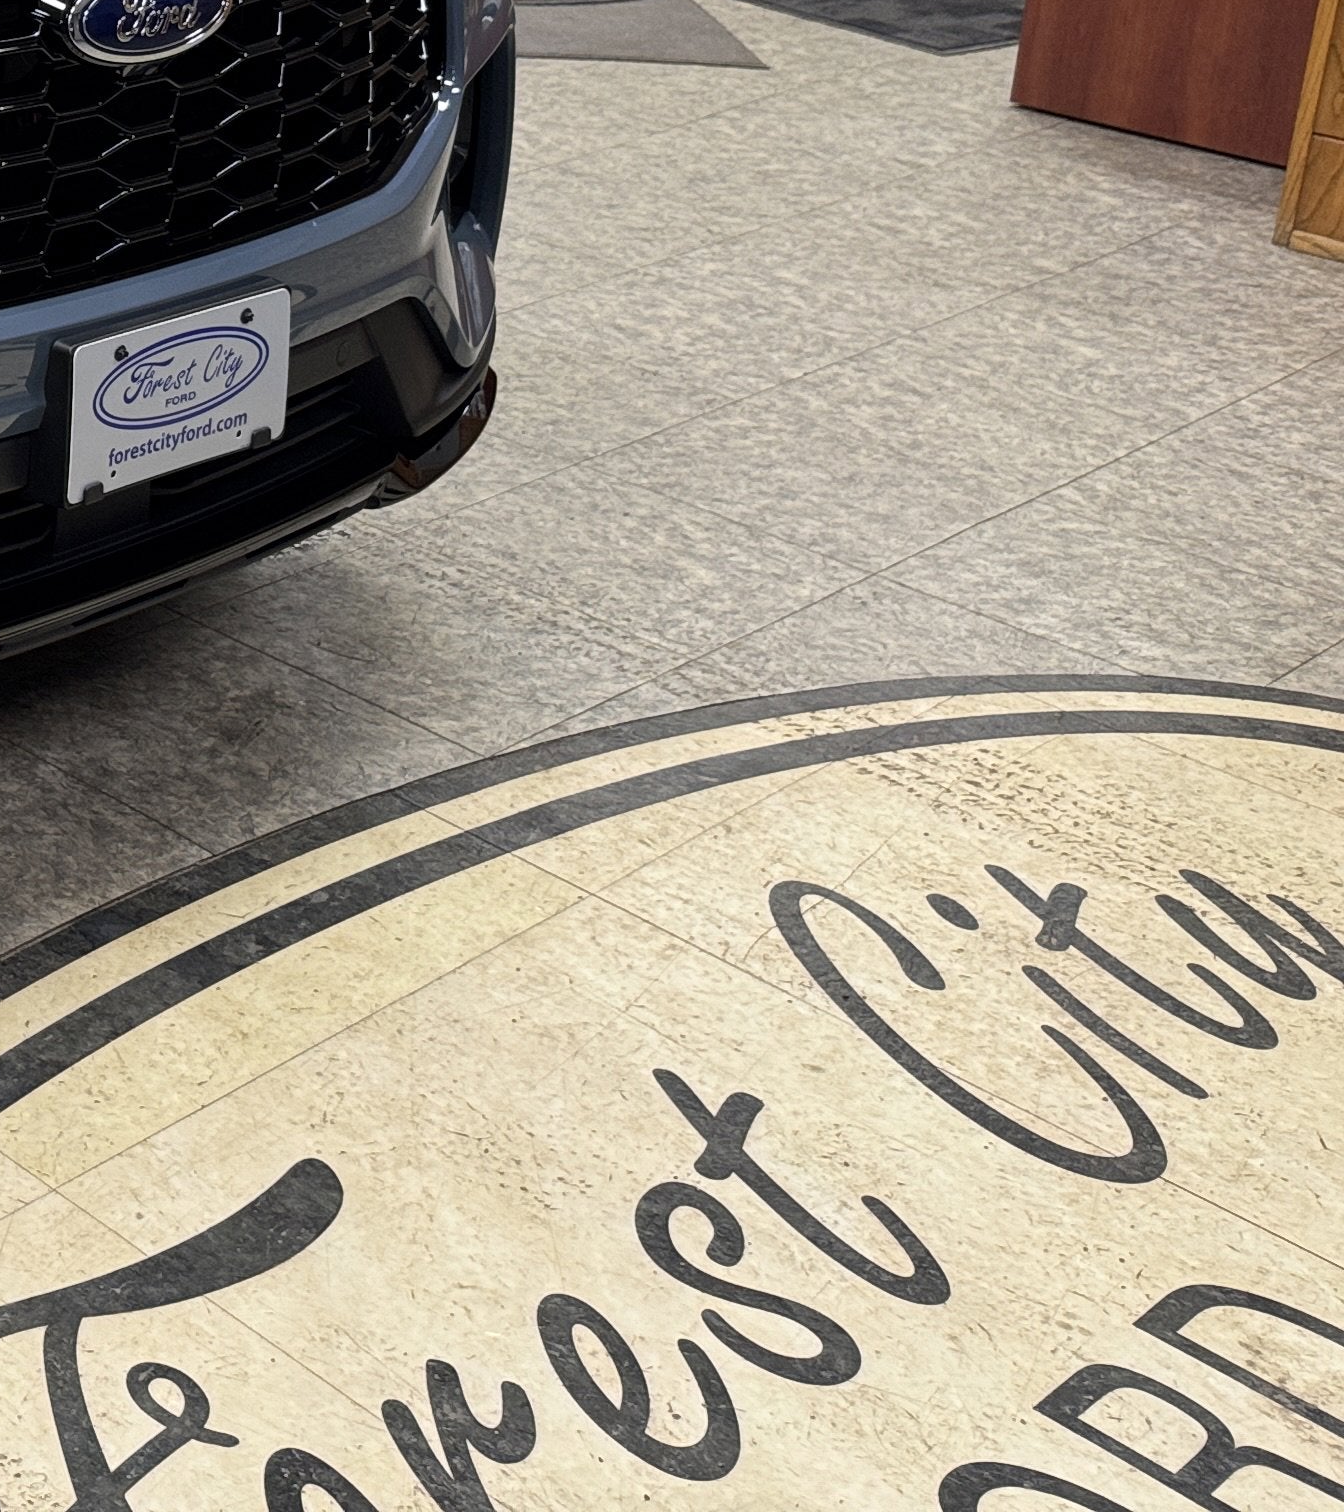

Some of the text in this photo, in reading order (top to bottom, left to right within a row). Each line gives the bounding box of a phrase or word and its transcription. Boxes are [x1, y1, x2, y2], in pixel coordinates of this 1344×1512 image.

[123, 344, 244, 405] Forest City
[165, 390, 196, 408] FORD
[108, 412, 248, 467] forestcityford.com
